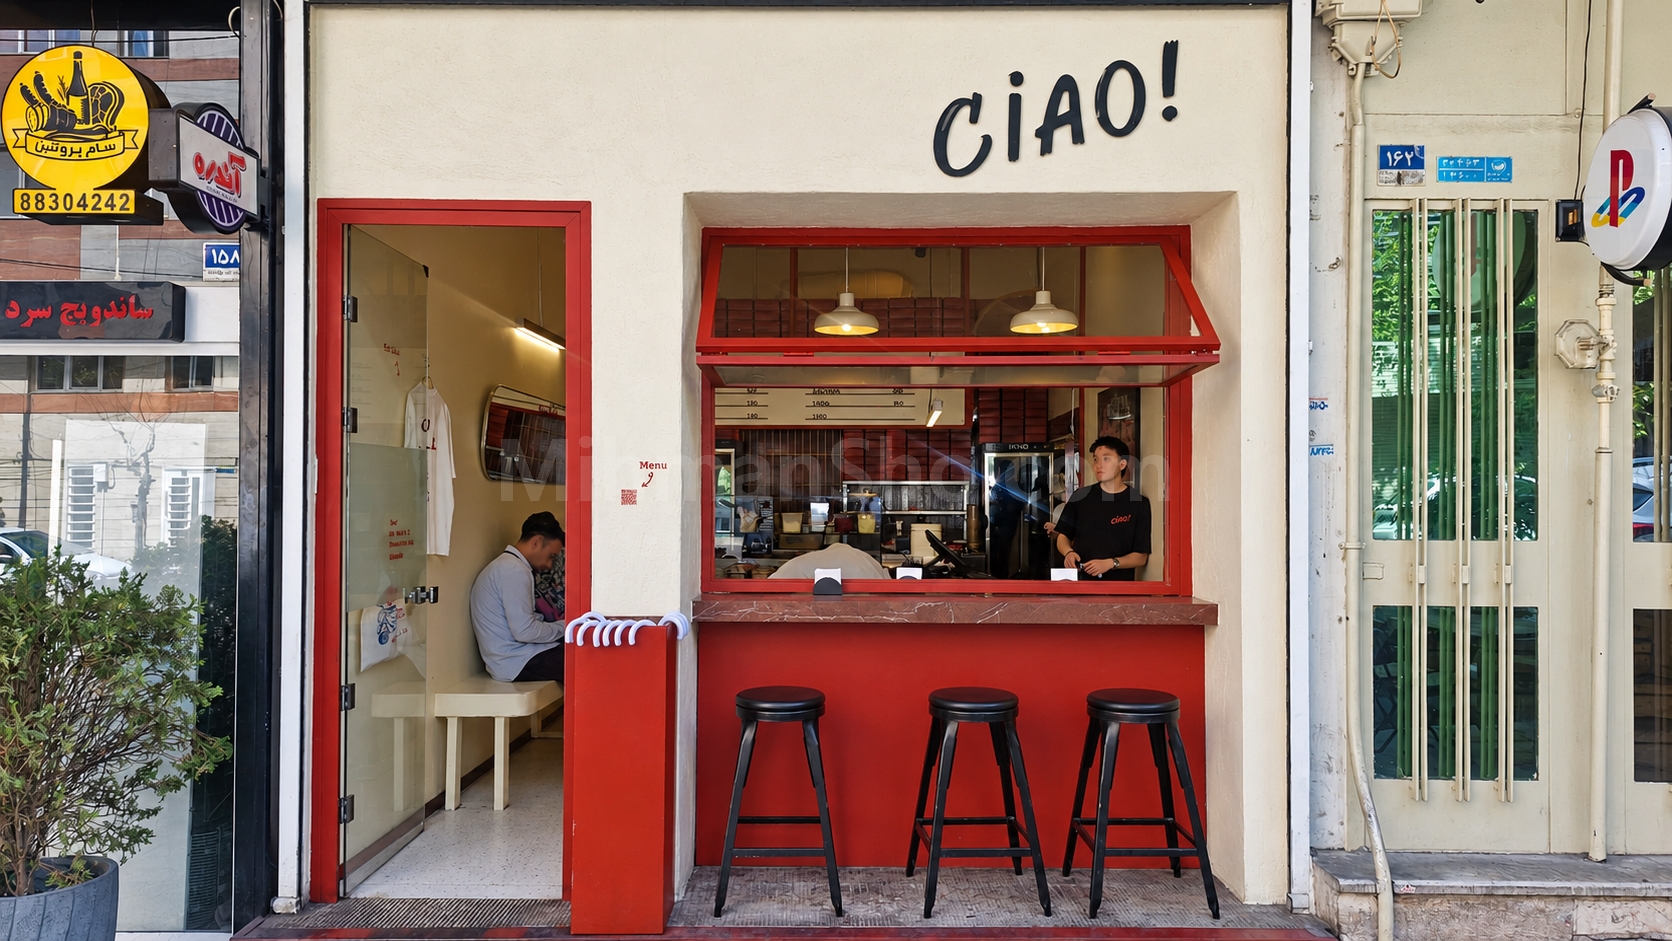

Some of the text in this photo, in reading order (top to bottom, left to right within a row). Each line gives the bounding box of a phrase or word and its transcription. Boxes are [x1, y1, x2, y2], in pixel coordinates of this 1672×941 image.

[85, 143, 117, 158] سام
[1386, 150, 1415, 167] ۱۶۲
[20, 192, 131, 212] 88304242
[211, 248, 240, 265] ۱۵۸
[4, 294, 154, 328] ساندویچ سرد
[639, 460, 667, 470] Menu
